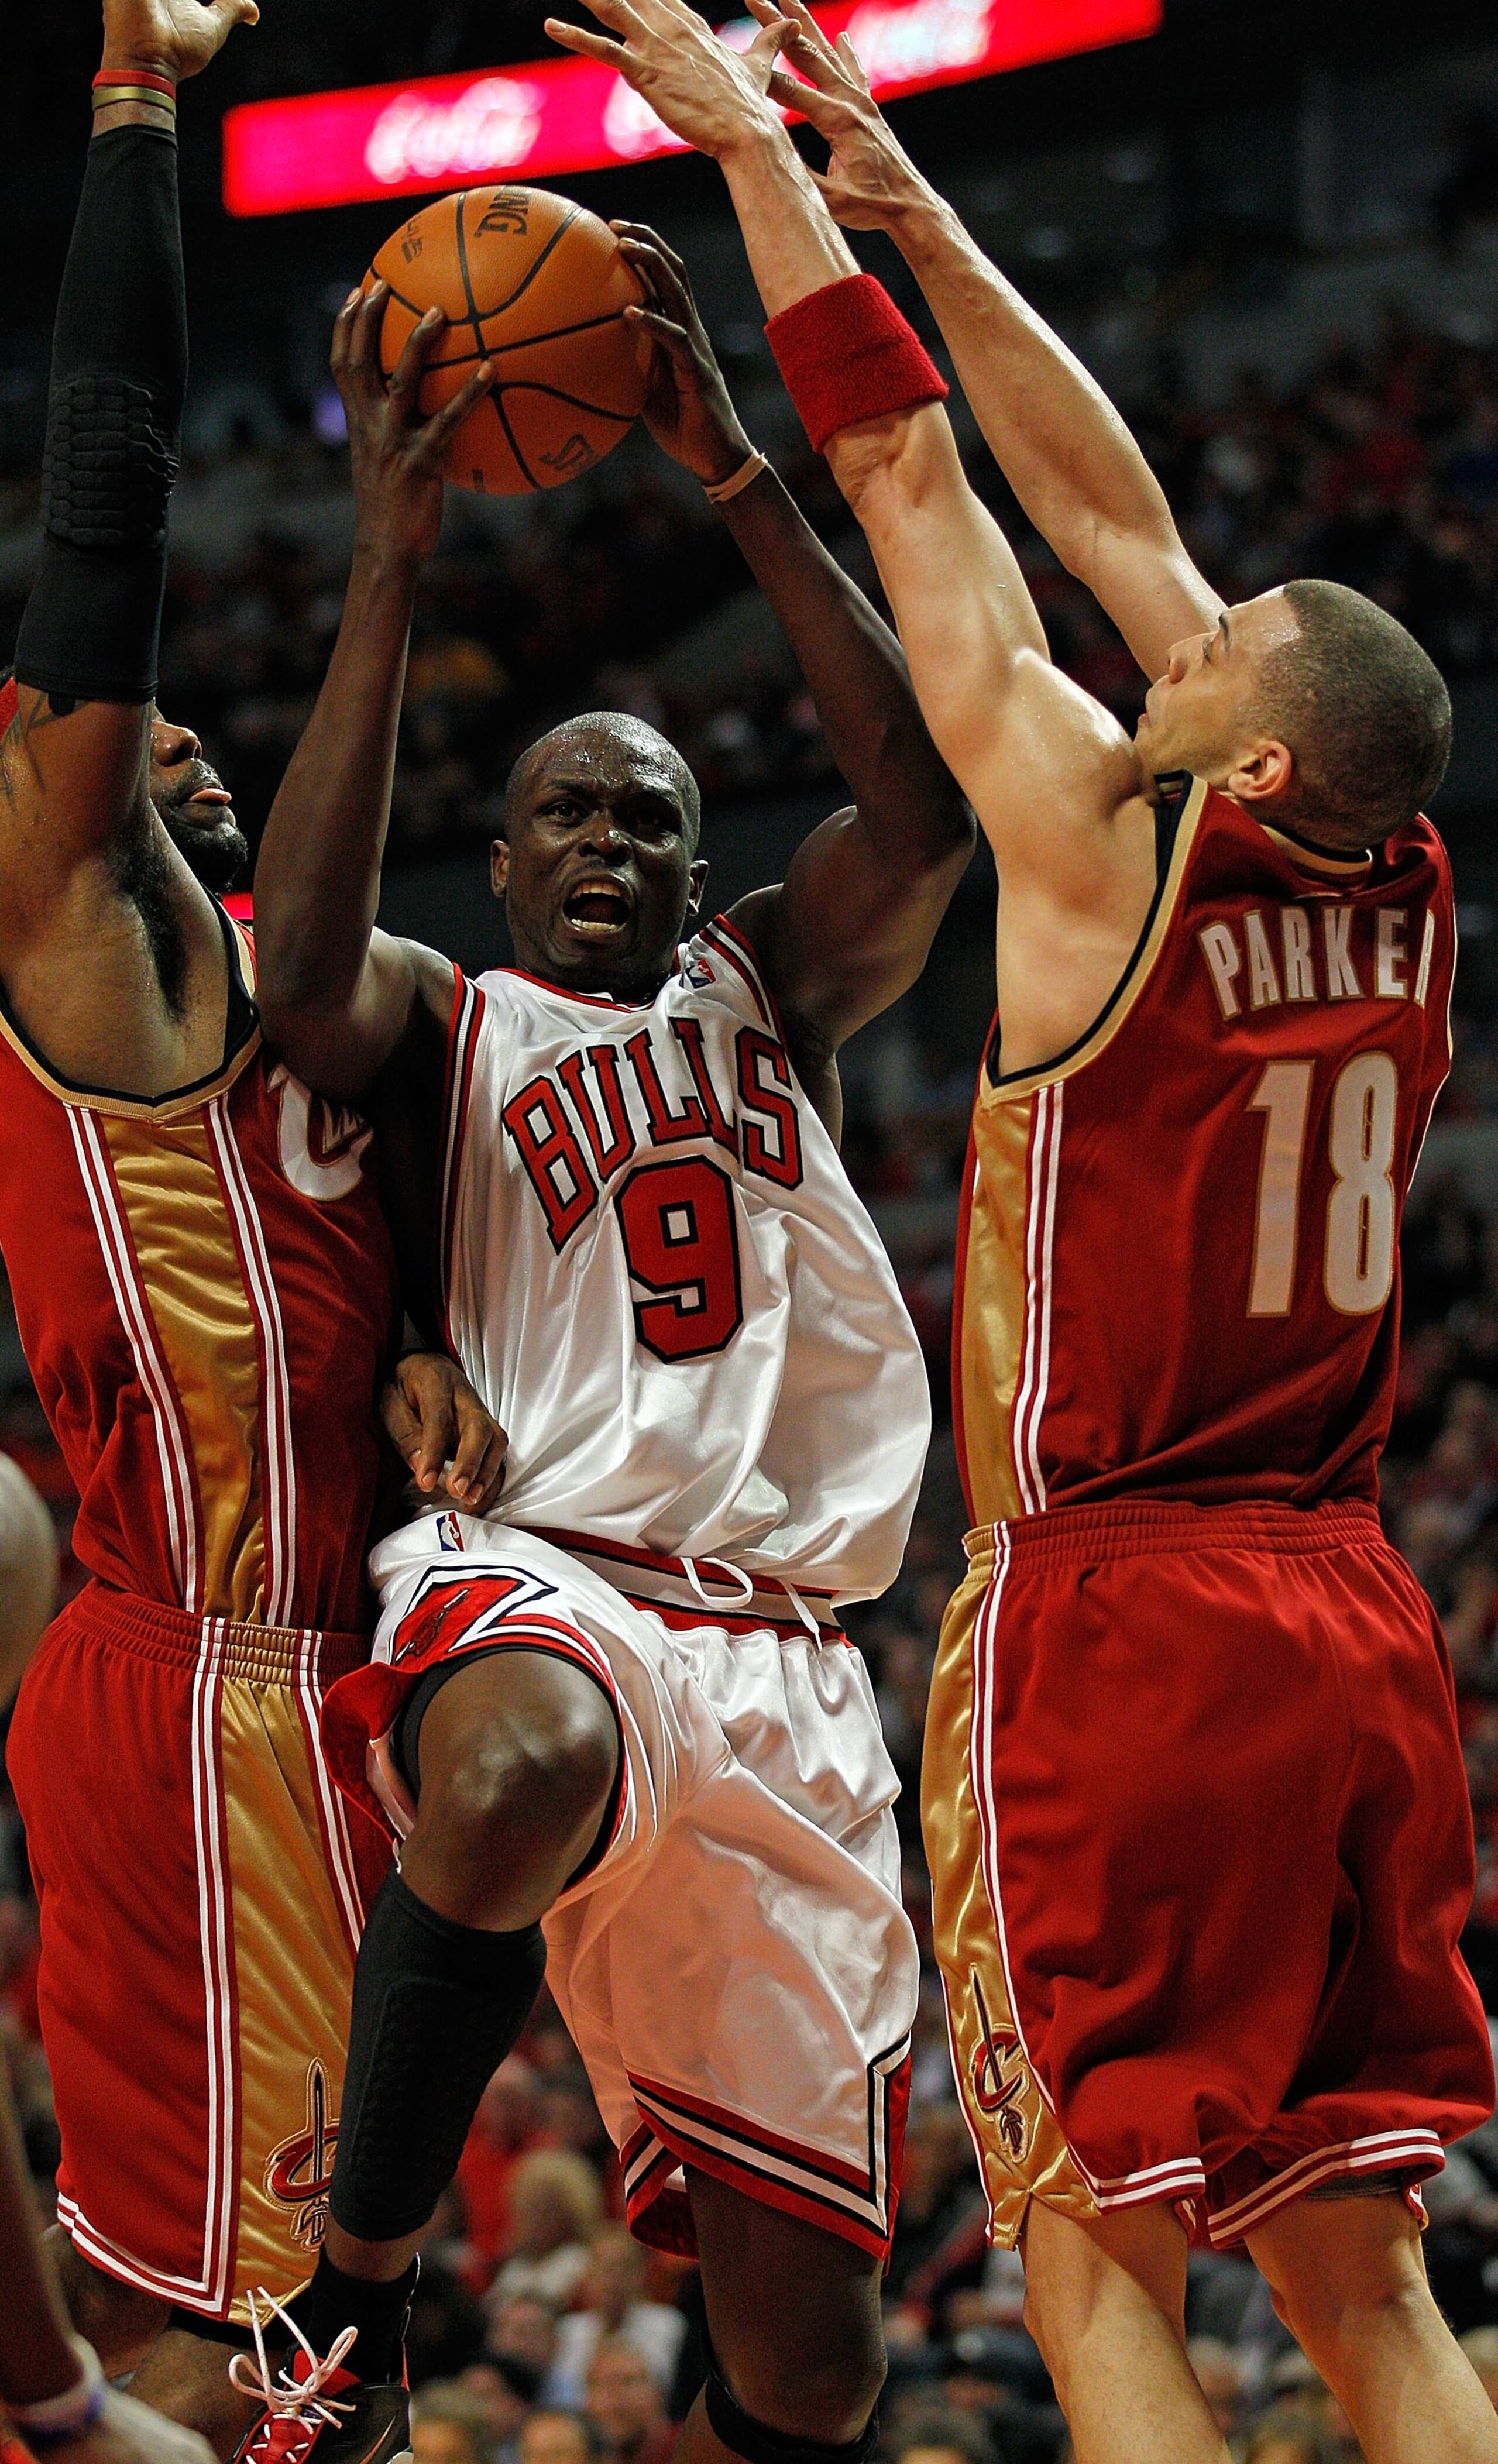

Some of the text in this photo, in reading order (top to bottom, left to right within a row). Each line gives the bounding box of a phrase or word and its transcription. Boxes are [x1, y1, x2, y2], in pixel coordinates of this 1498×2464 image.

[502, 1016, 803, 1255] BULLS
[1245, 1051, 1398, 1318] 18
[613, 1155, 744, 1364] 9
